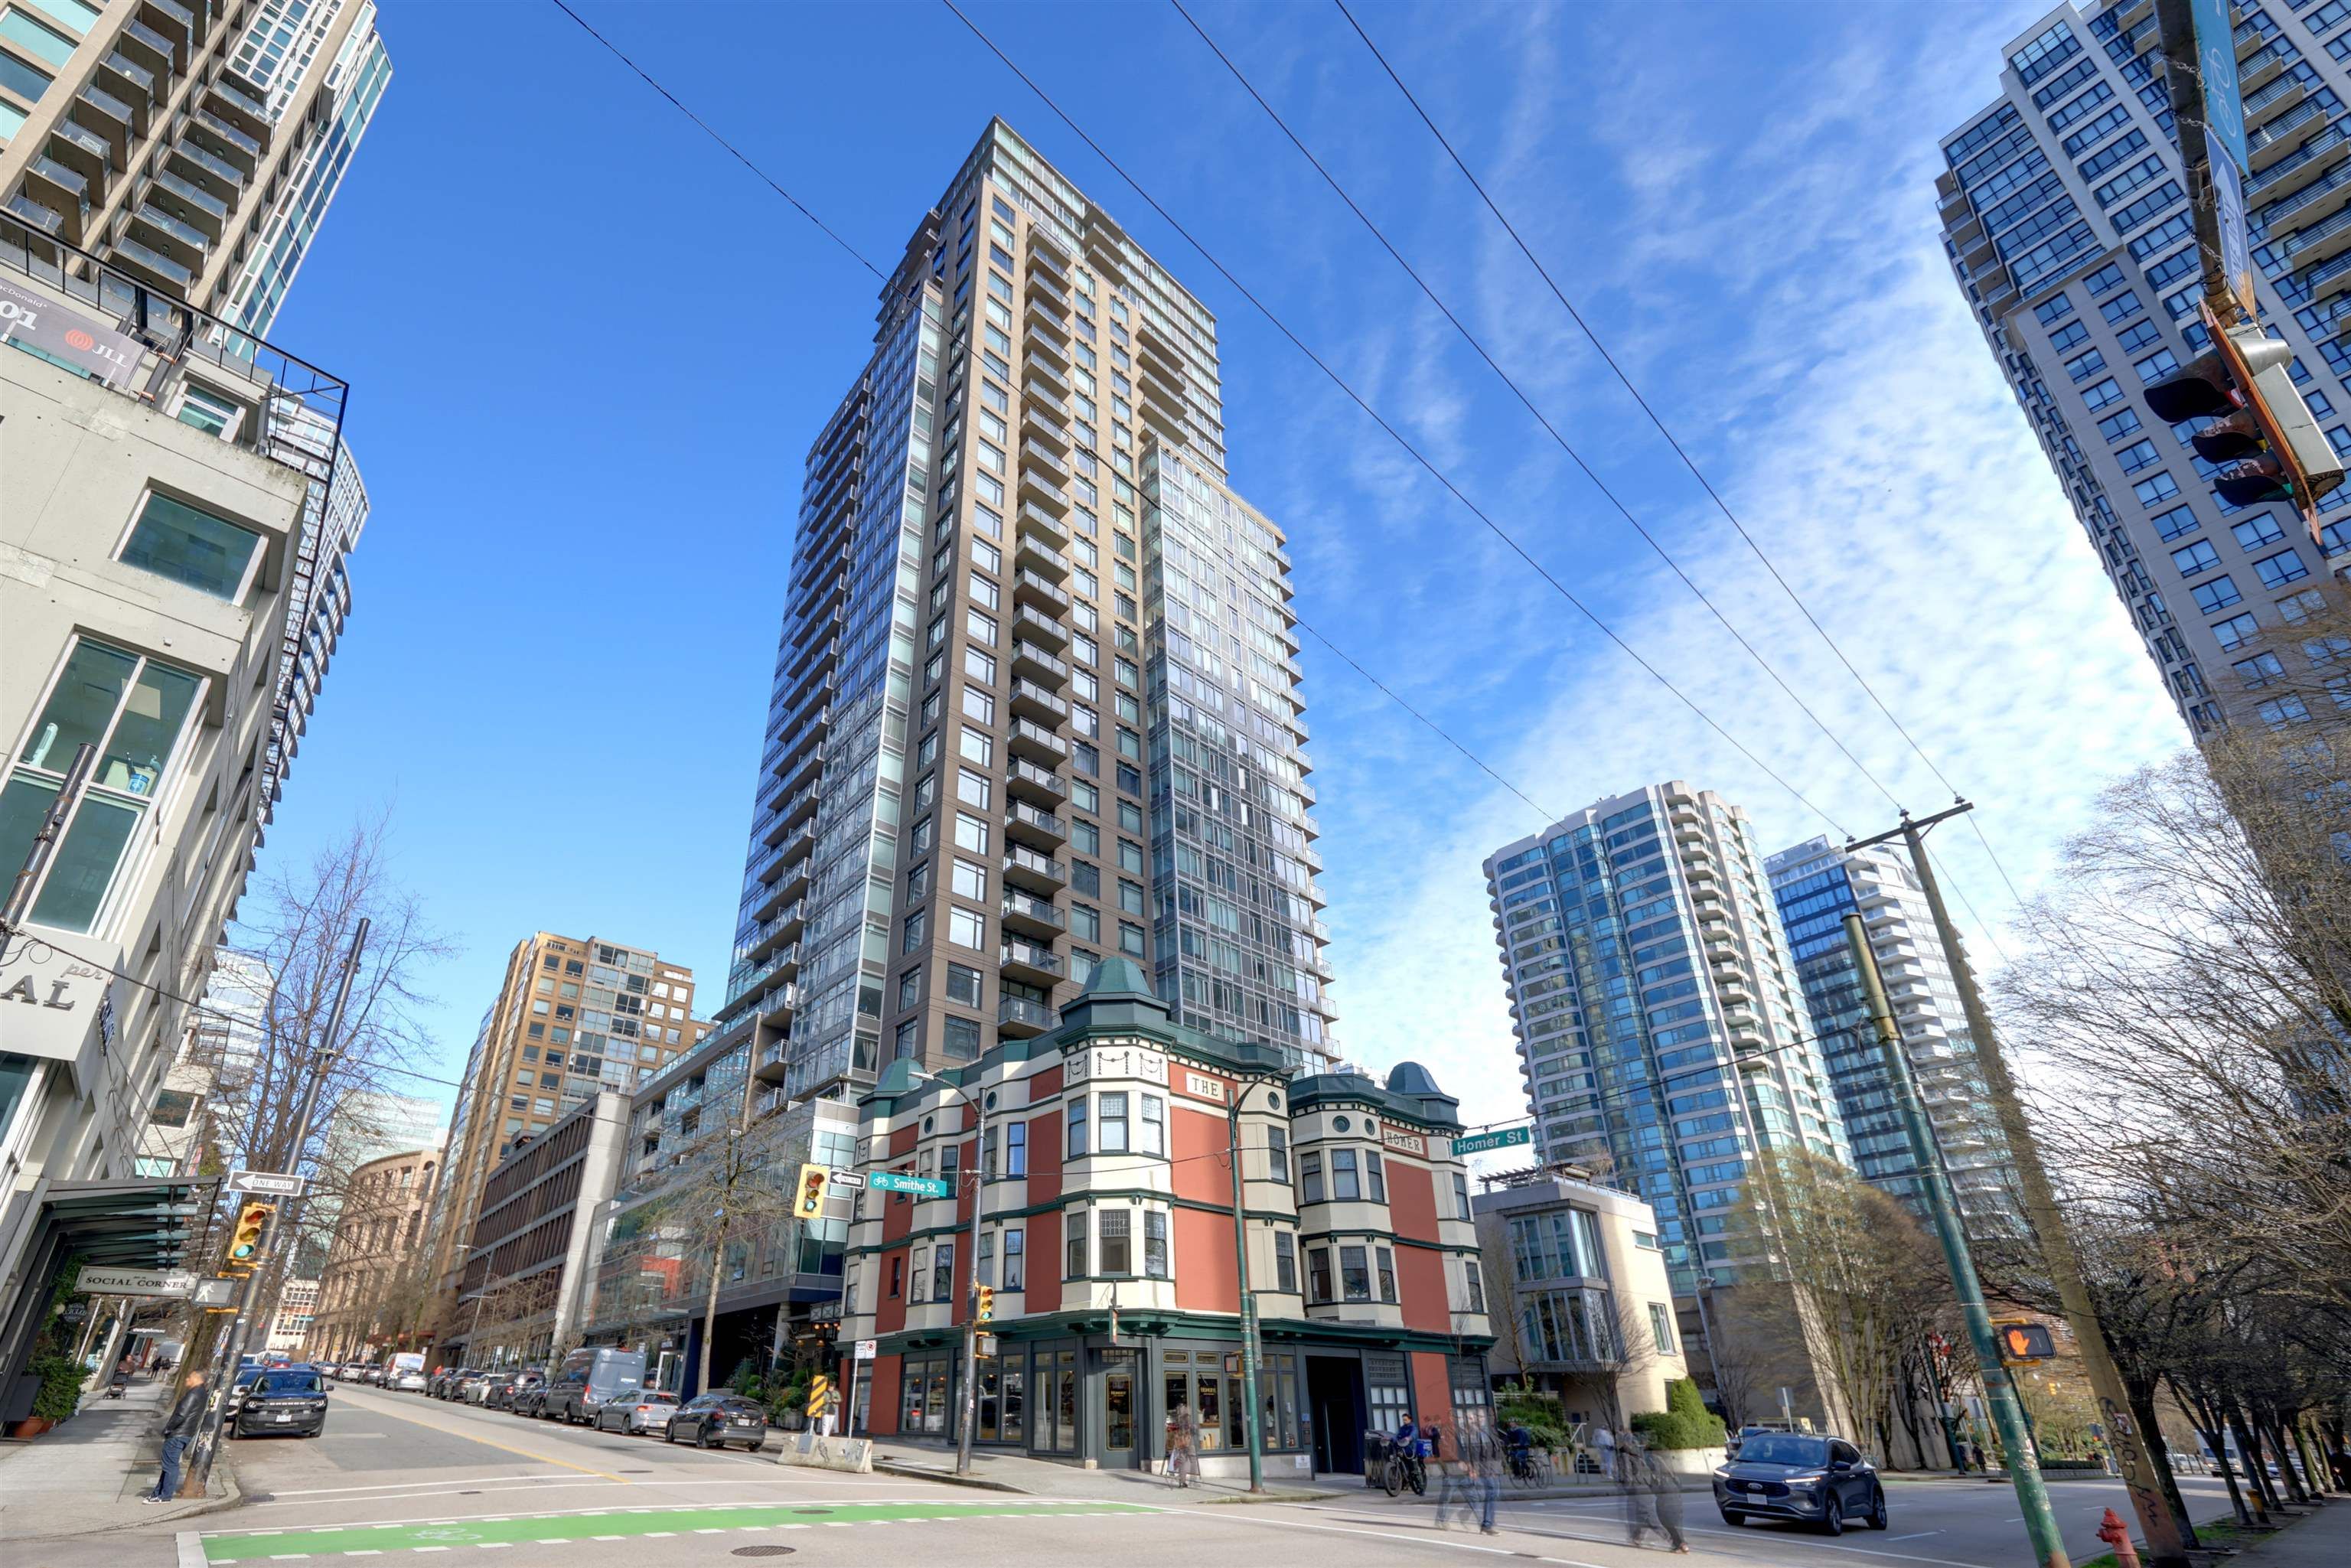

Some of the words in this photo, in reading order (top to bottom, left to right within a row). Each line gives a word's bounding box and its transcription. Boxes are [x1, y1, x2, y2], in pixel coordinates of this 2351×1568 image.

[92, 344, 129, 367] JLL
[60, 963, 103, 980] per
[0, 970, 75, 1011] AL
[1192, 1077, 1218, 1097] THE
[1386, 1131, 1420, 1151] HOMER
[1457, 1136, 1500, 1153] Homer
[1506, 1131, 1522, 1144] St
[252, 1178, 270, 1188] ONE
[274, 1181, 292, 1189] WAY
[893, 1178, 925, 1192] Smithe
[927, 1182, 939, 1194] St.
[86, 1276, 132, 1286] SOCIAL
[137, 1280, 187, 1289] CORNER
